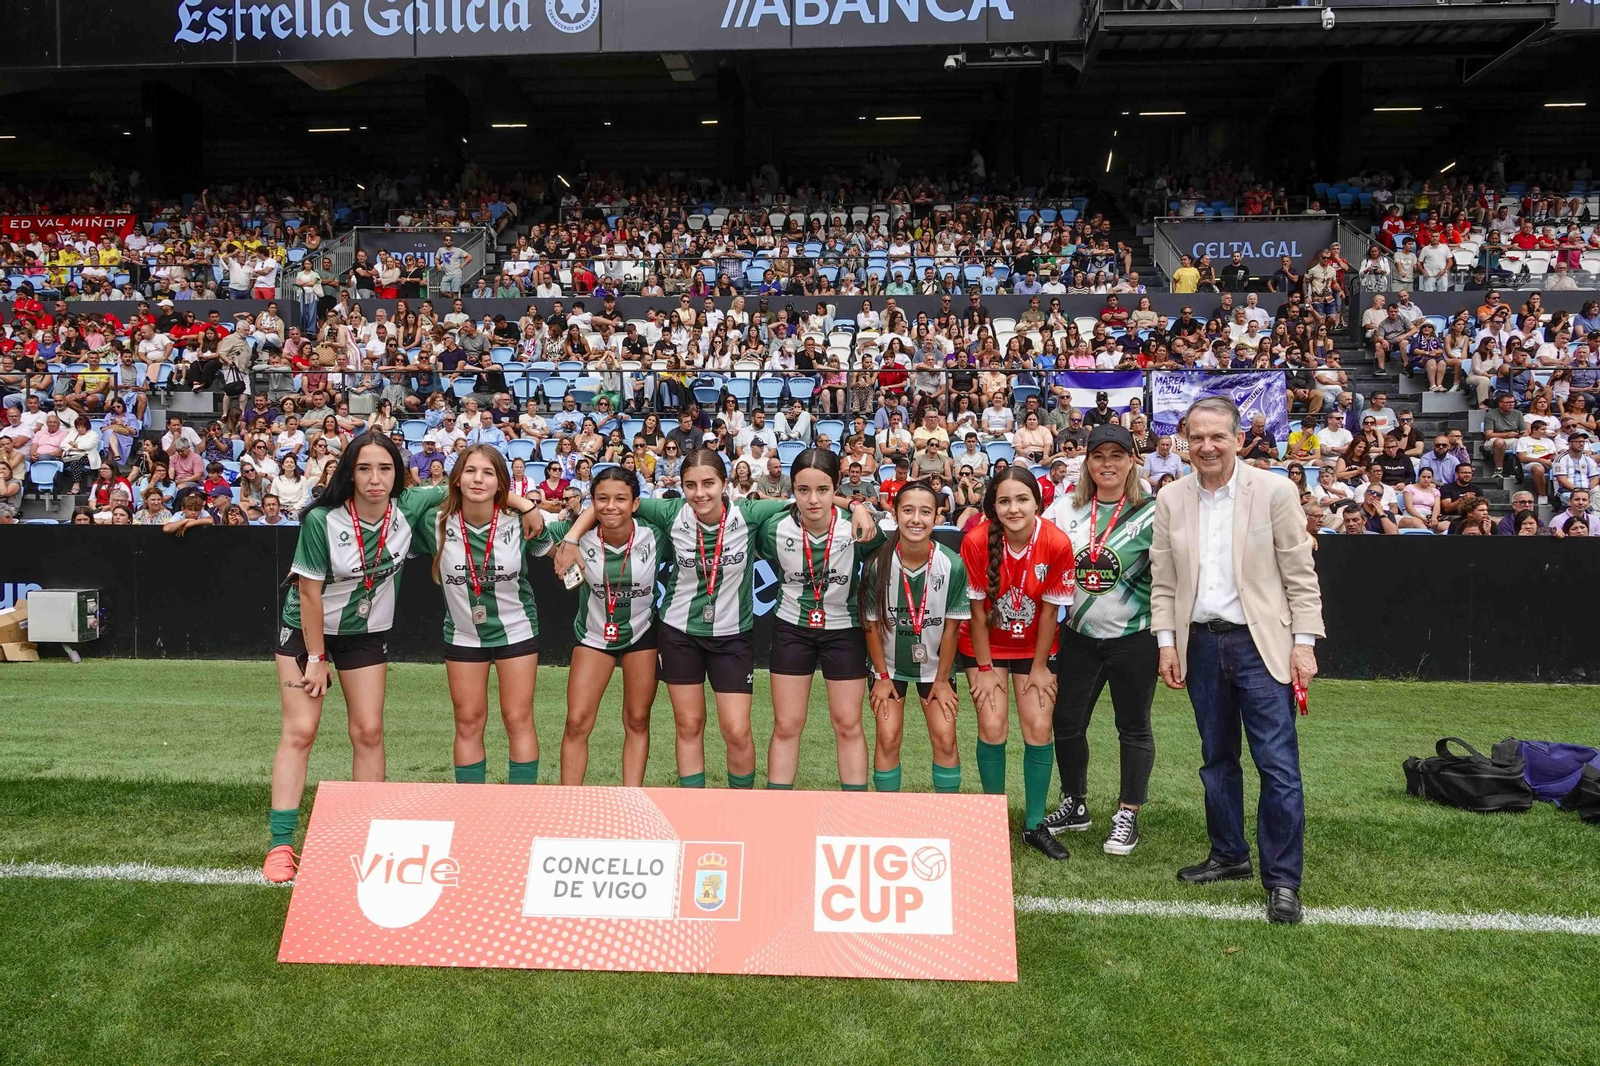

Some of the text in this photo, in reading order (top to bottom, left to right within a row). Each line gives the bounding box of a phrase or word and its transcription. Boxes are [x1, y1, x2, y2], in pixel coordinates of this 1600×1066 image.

[174, 0, 532, 43] Estrella Galicia
[9, 216, 126, 229] ED VAL MIÑOR
[1192, 240, 1302, 259] CELTA.GAL
[1155, 376, 1185, 387] MAREA
[1158, 385, 1183, 395] AZUL
[543, 856, 664, 876] CONCELLO
[553, 880, 647, 900] DE VIGO
[821, 884, 924, 923] CUP
